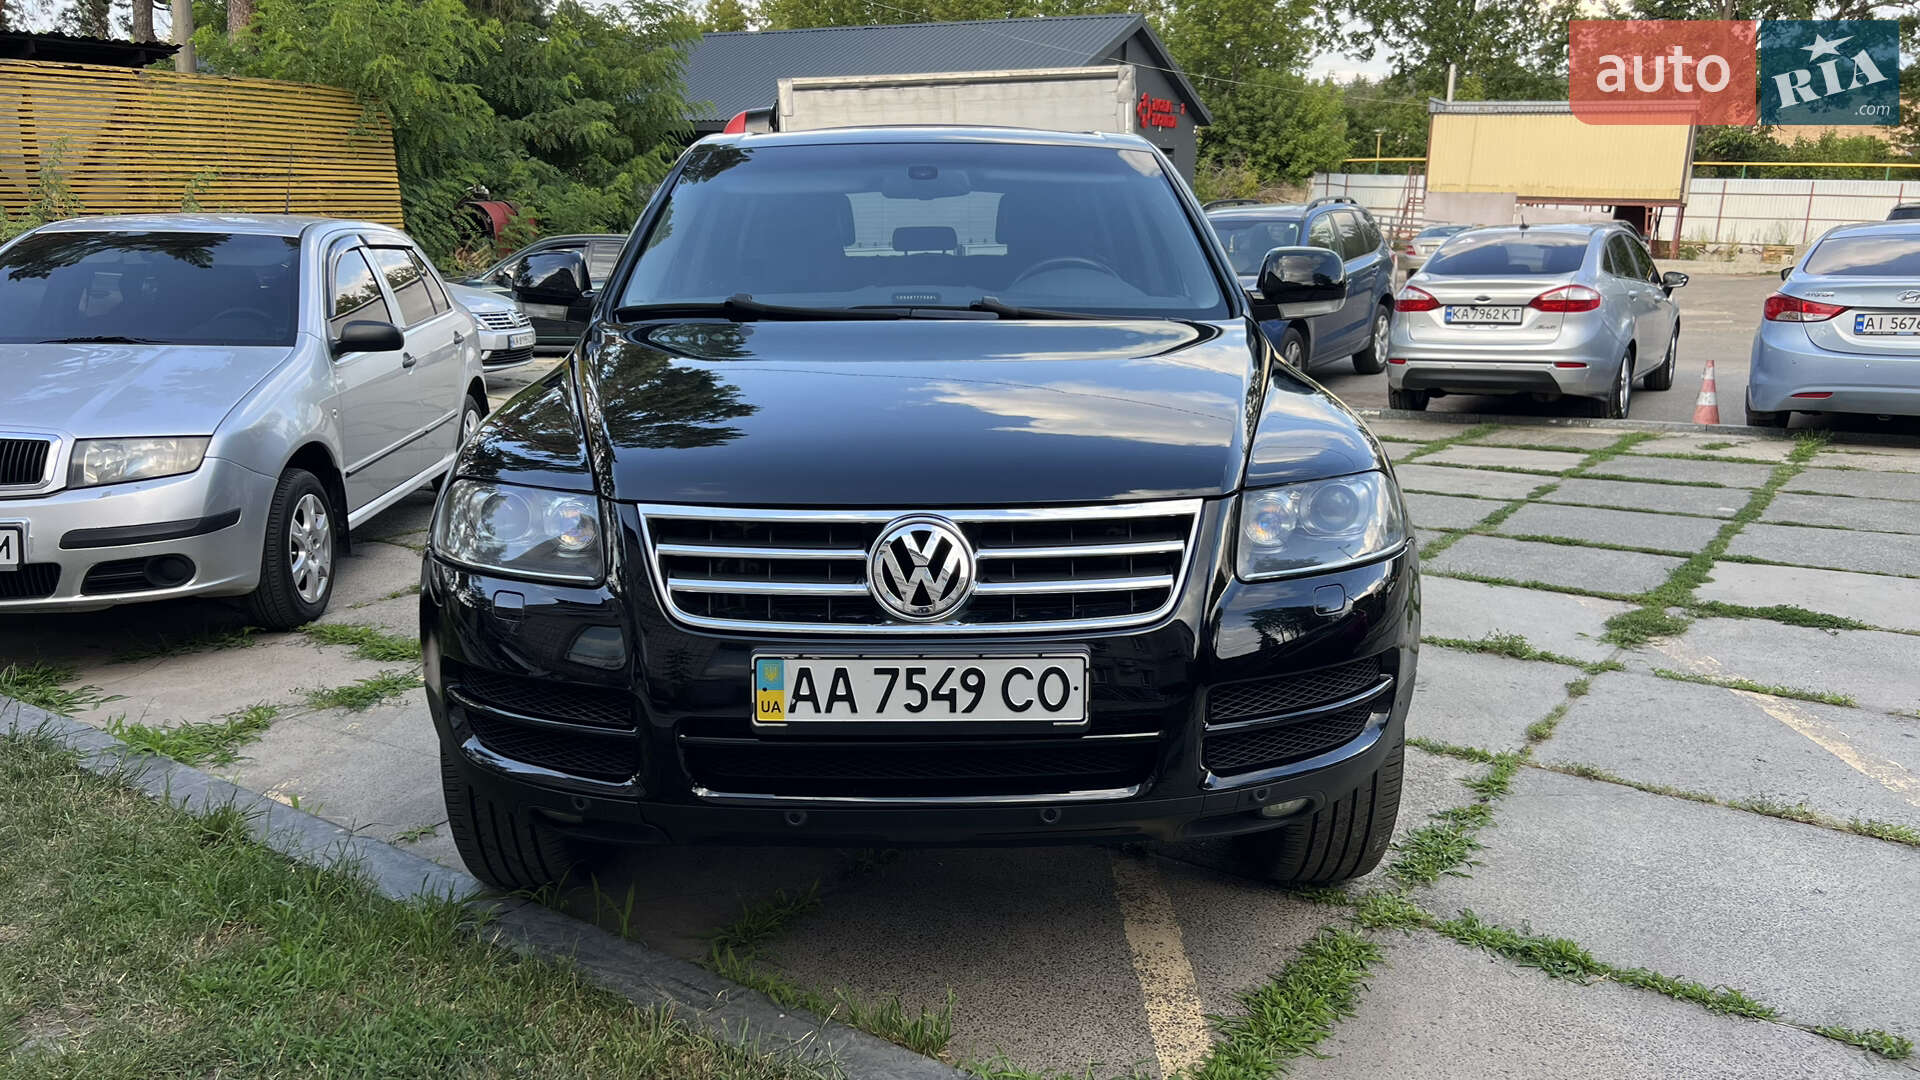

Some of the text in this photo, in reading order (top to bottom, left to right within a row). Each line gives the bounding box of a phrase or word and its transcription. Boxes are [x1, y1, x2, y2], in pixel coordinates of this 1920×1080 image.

[788, 666, 1071, 714] AA 7549 CO
[761, 700, 782, 713] UA
